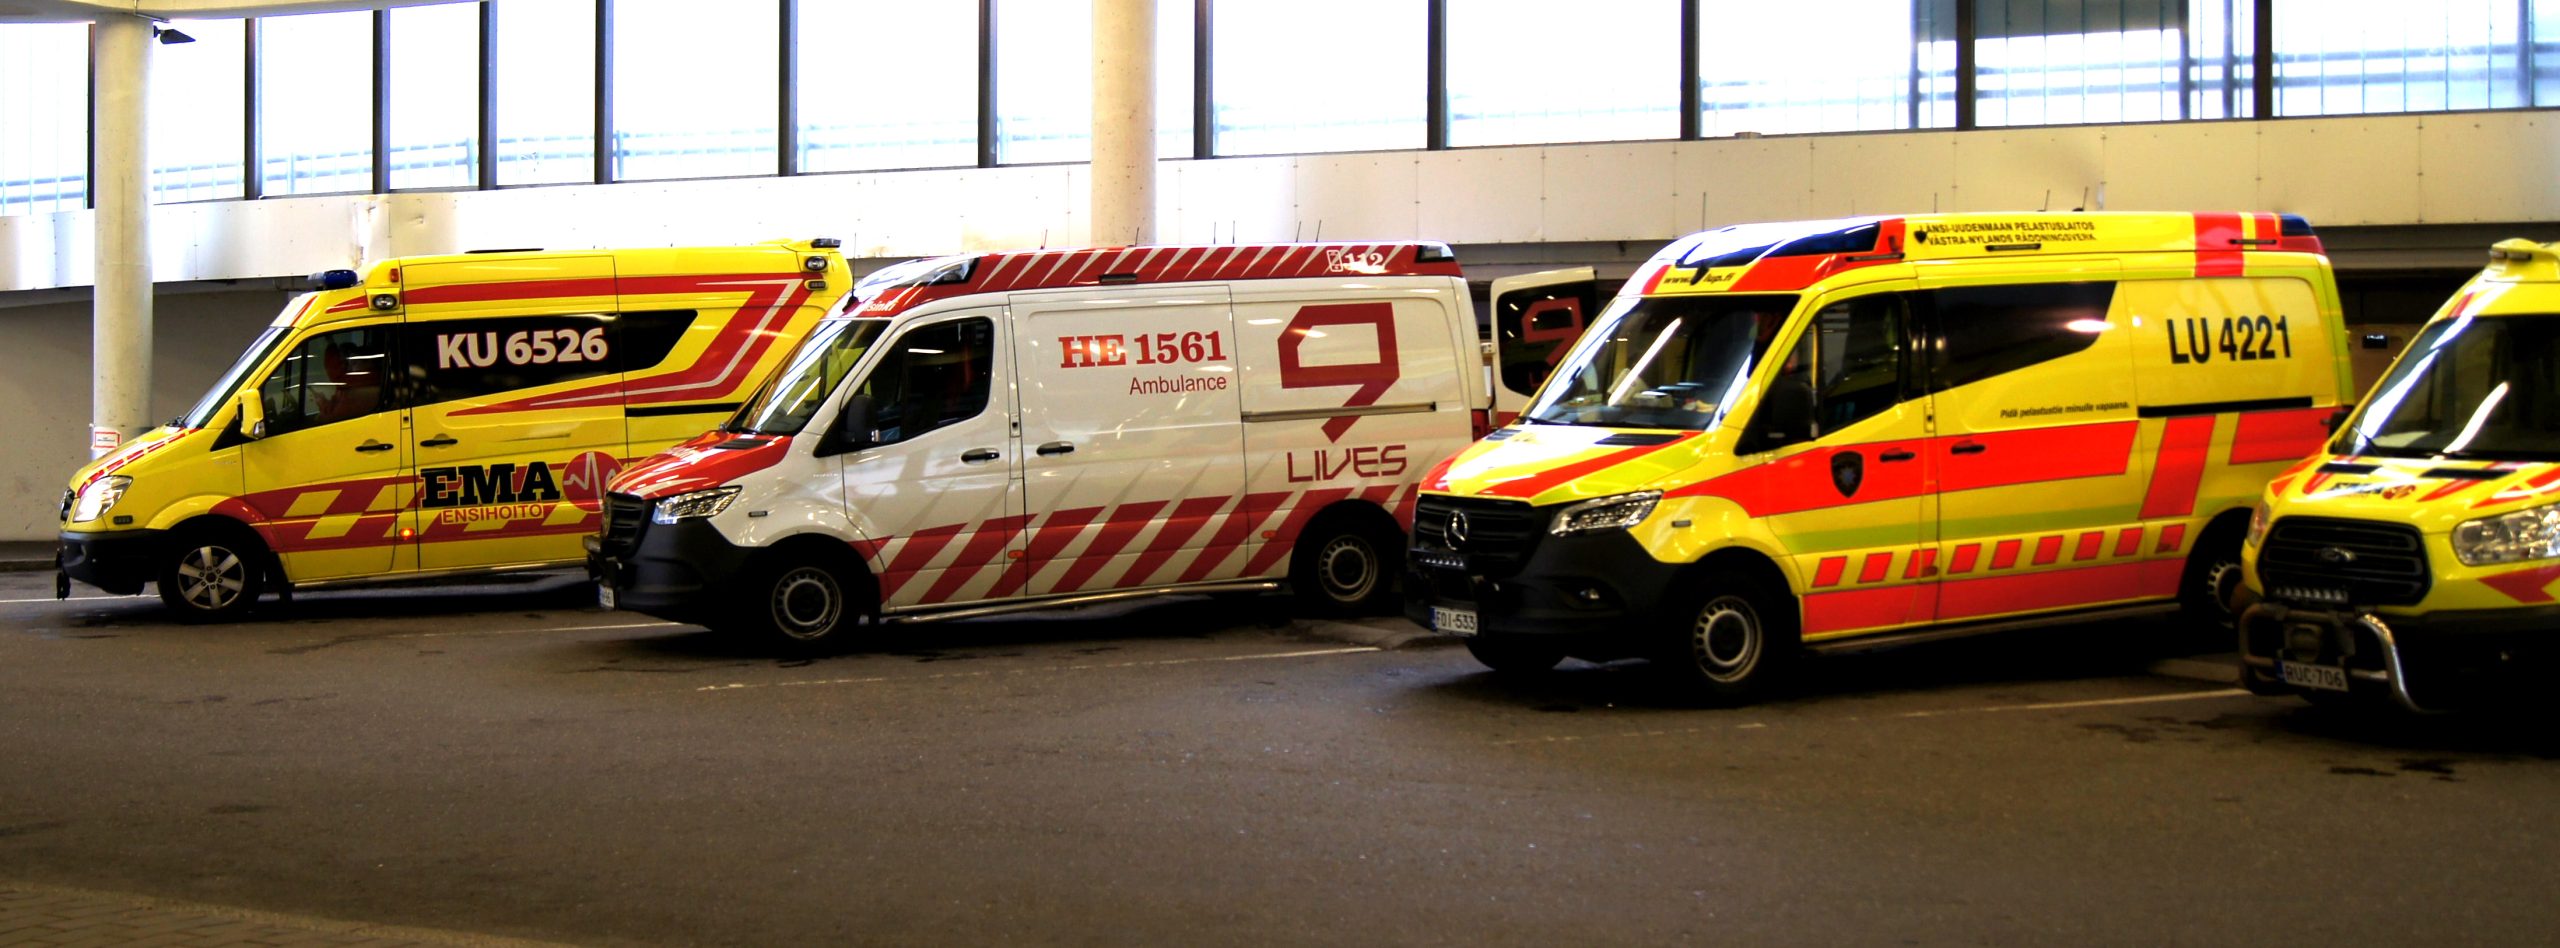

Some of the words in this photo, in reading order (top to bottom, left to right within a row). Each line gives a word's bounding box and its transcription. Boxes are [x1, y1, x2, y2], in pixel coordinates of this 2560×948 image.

[2014, 221, 2095, 231] PELASTUSLAITOS
[1344, 253, 1385, 272] 112
[437, 332, 498, 369] KU
[505, 327, 608, 366] 6526
[1058, 334, 1127, 369] HE
[1134, 331, 1227, 365] 1561
[2166, 317, 2211, 364] LU
[2218, 315, 2291, 361] 4221
[1130, 374, 1227, 395] Ambulance
[1277, 302, 1400, 444] 9
[1287, 444, 1407, 484] LIVES
[420, 461, 560, 508] EMA
[443, 504, 543, 524] ENSIHOITO
